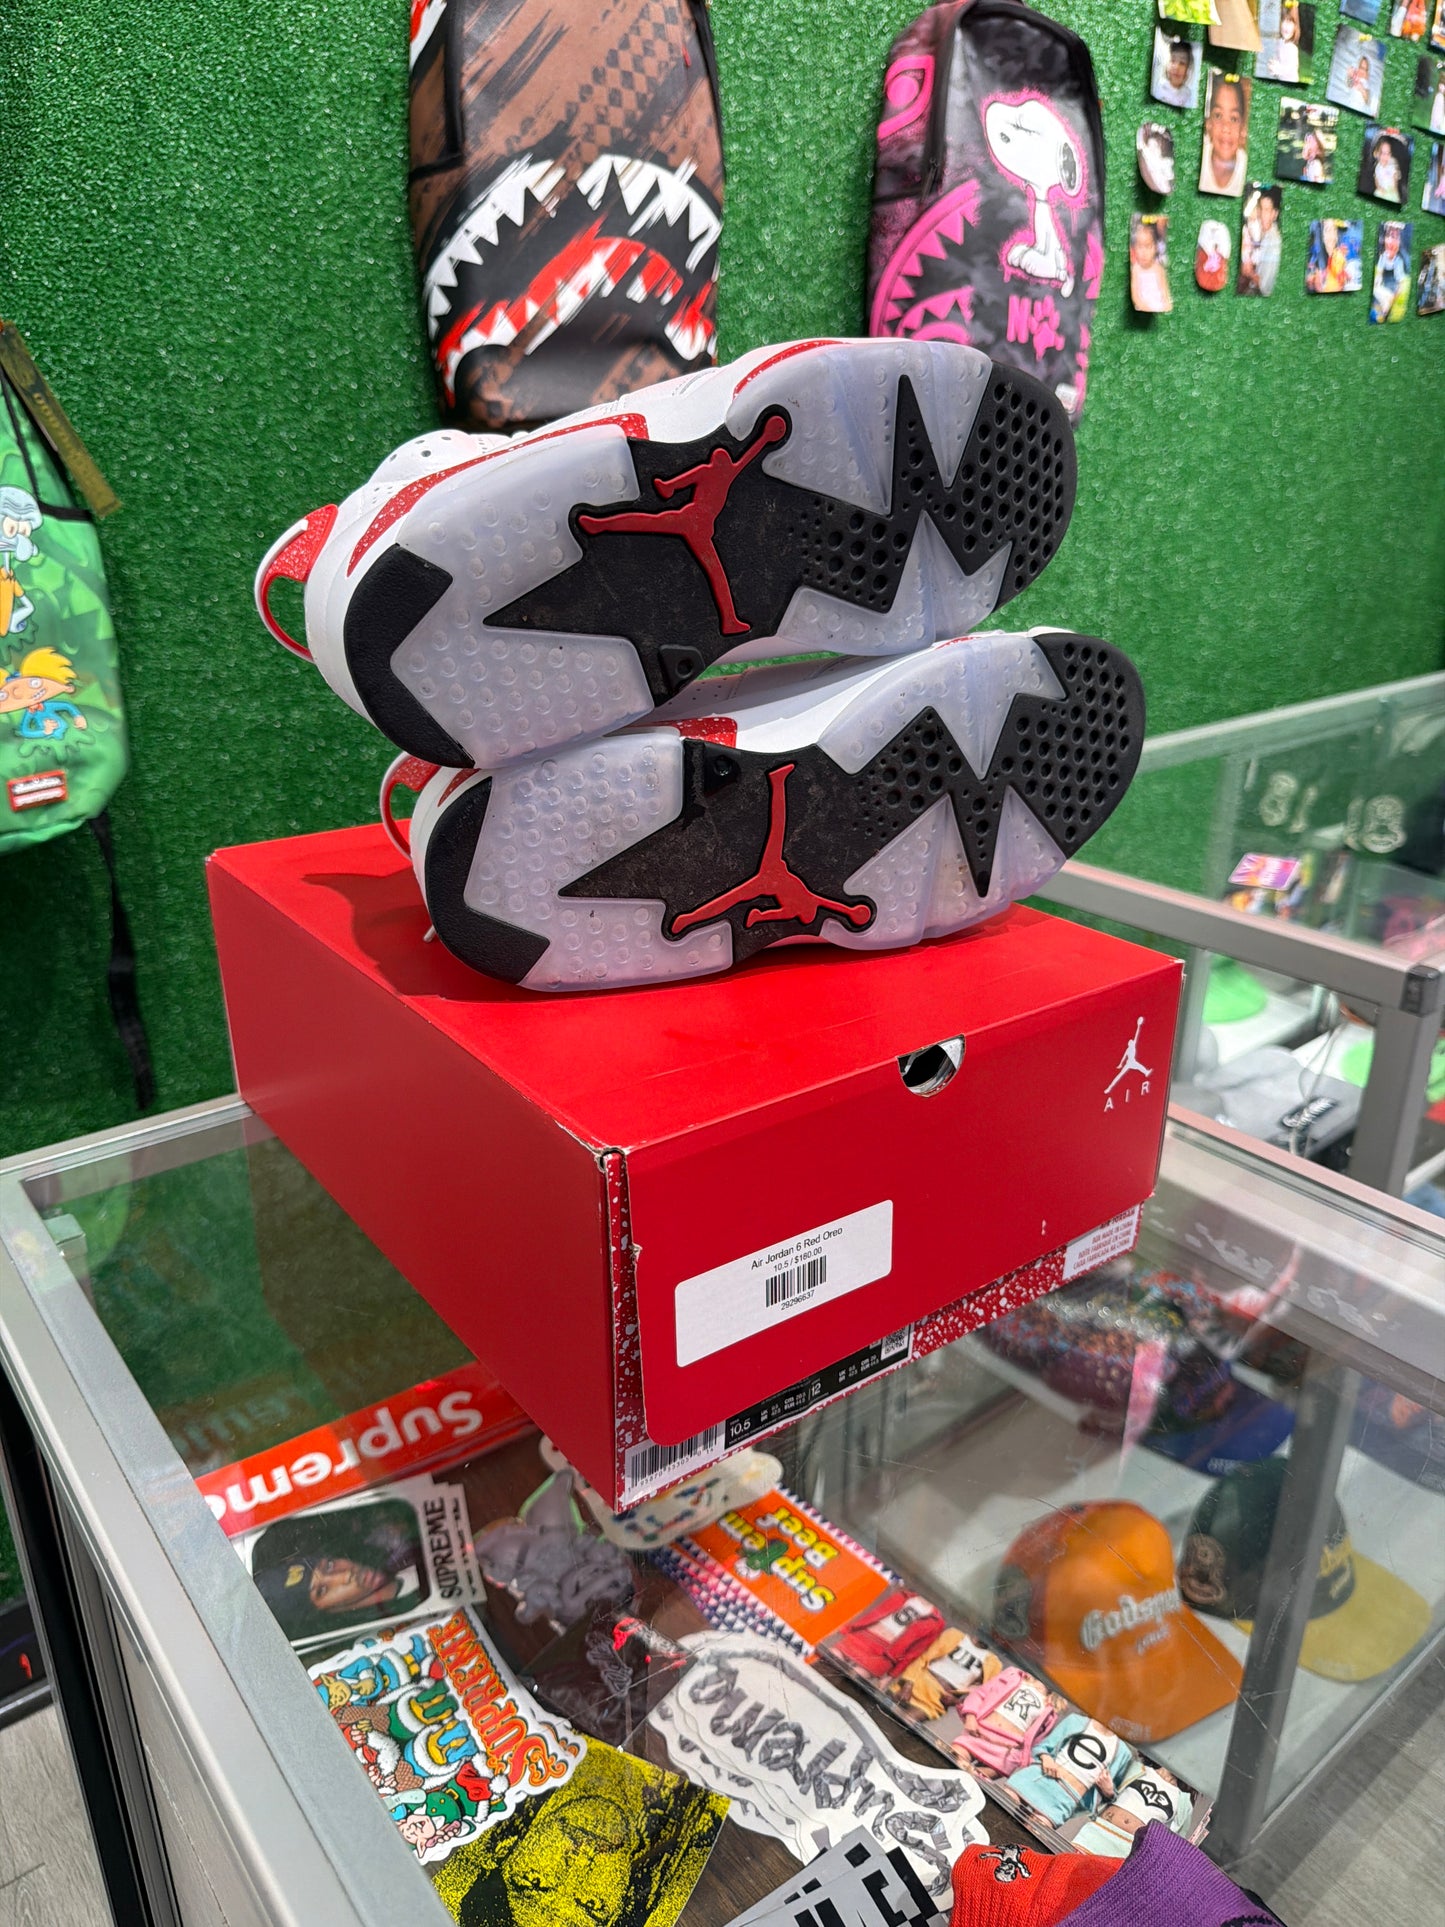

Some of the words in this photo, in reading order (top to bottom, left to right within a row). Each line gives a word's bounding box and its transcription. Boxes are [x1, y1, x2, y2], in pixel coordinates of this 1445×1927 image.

[1103, 1081, 1150, 1112] AIR
[751, 1258, 764, 1270] Air
[765, 1246, 794, 1265] Jordan
[796, 1242, 802, 1252] 6
[804, 1234, 820, 1248] Red
[822, 1227, 843, 1241] Oreo
[774, 1260, 788, 1272] 10.5
[780, 1290, 814, 1310] 29296637
[812, 1383, 822, 1396] 12
[730, 1418, 751, 1438] 10.5
[424, 1496, 462, 1598] SUPREME
[756, 1506, 839, 1570] Beef
[427, 1609, 568, 1788] SUPREME
[1004, 1688, 1042, 1720] R
[1142, 1784, 1165, 1806] ME
